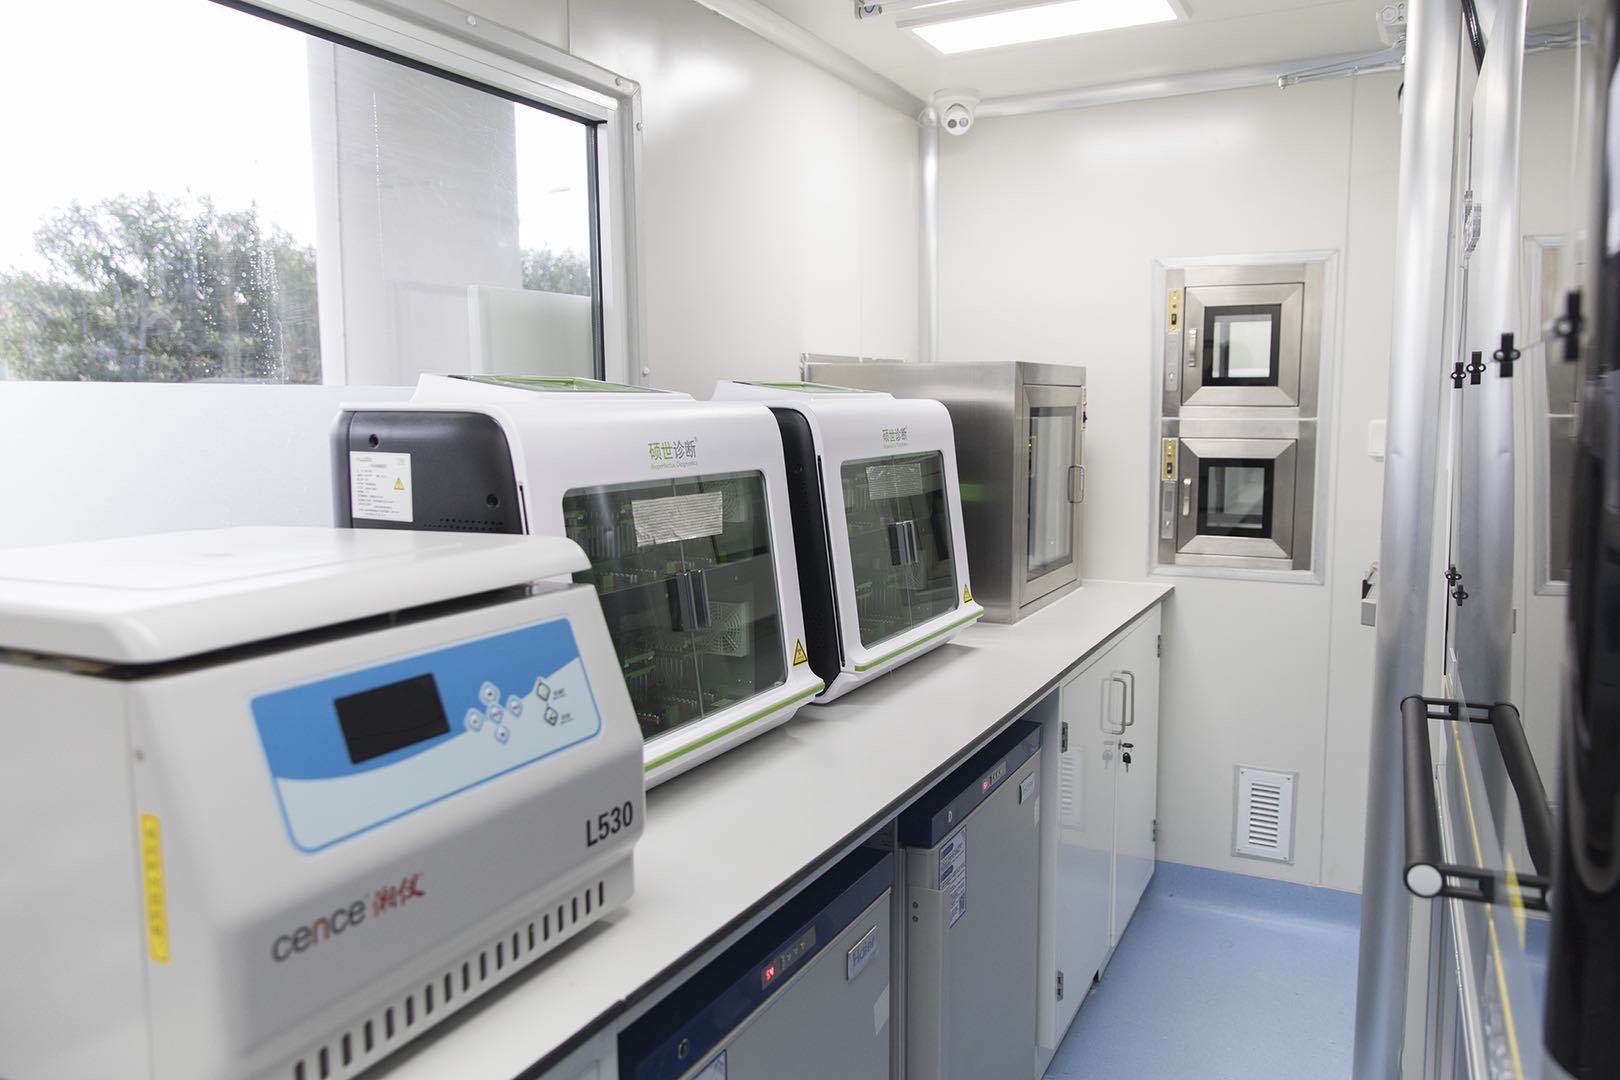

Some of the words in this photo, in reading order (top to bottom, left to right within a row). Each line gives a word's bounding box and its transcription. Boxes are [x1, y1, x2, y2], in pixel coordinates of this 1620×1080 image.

[648, 440, 696, 460] 硕世诊断
[586, 801, 634, 847] L530
[272, 899, 366, 963] cence
